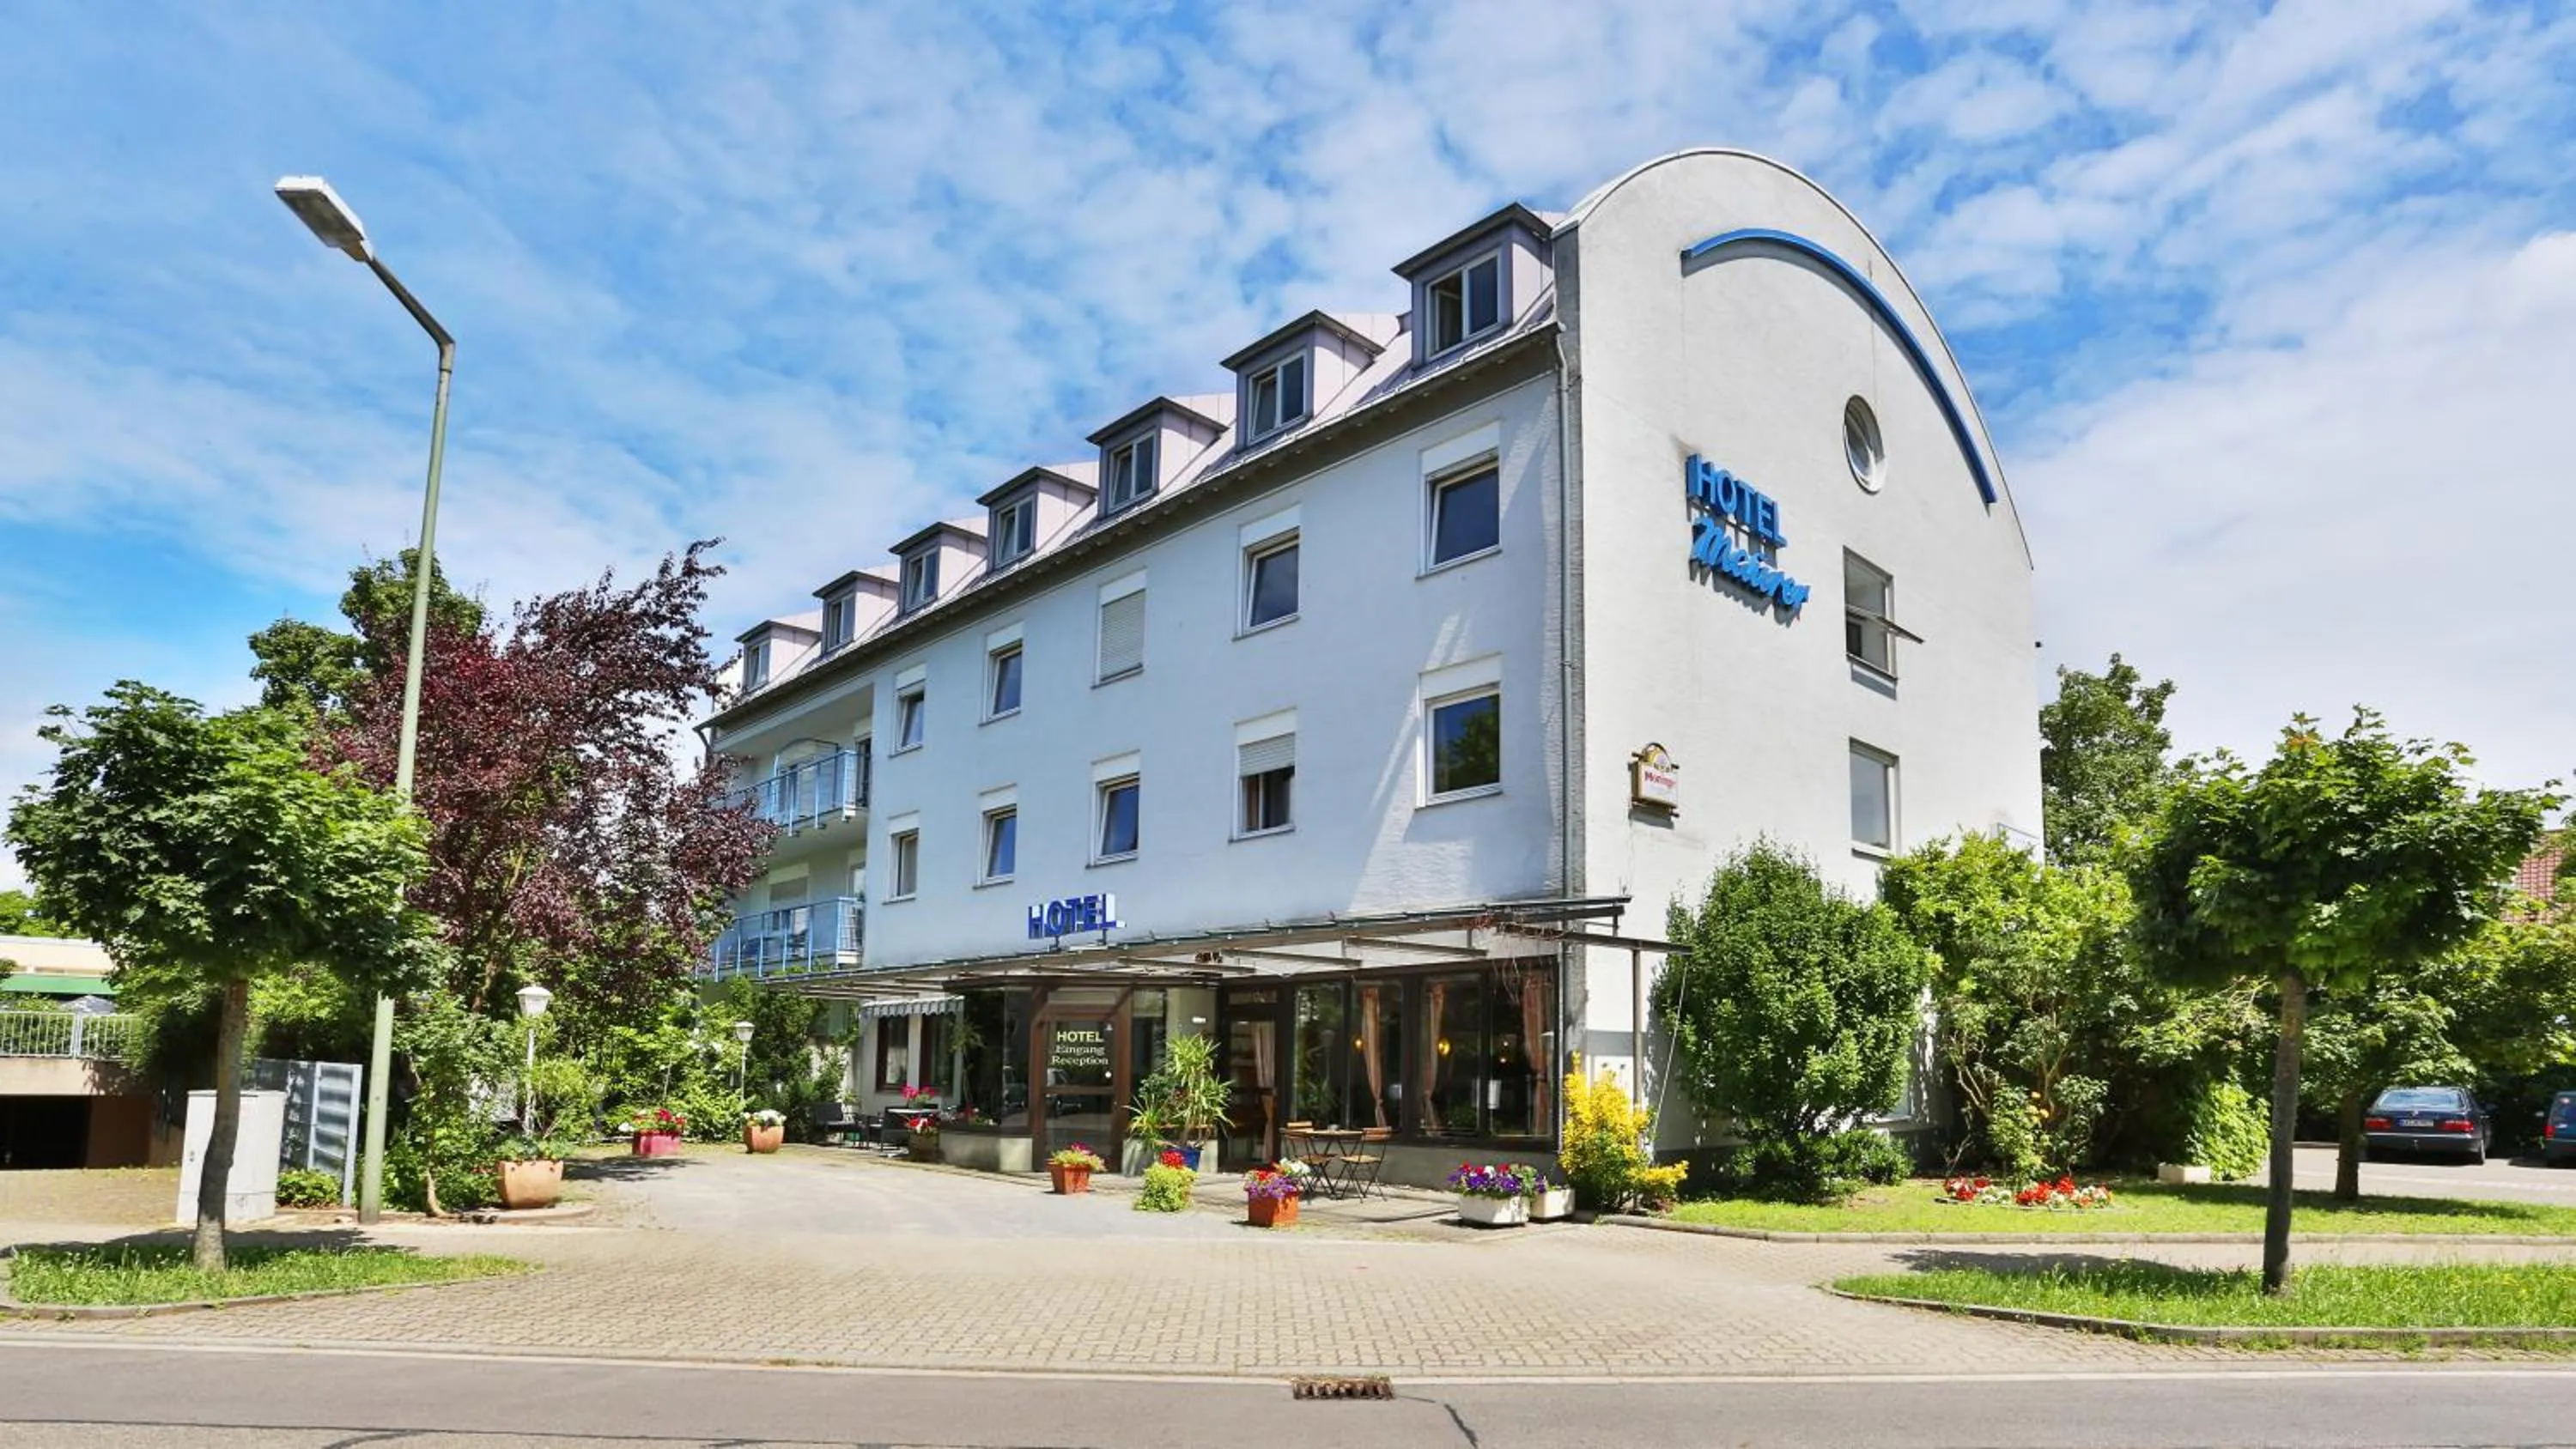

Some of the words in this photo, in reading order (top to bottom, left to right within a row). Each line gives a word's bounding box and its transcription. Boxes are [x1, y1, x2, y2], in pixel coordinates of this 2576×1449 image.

[1686, 453, 1788, 548] HOTEL
[1029, 893, 1126, 939] HOTEL
[1057, 1031, 1104, 1042] HOTEL
[1055, 1045, 1105, 1056] Eingang
[1051, 1055, 1109, 1066] Reception
